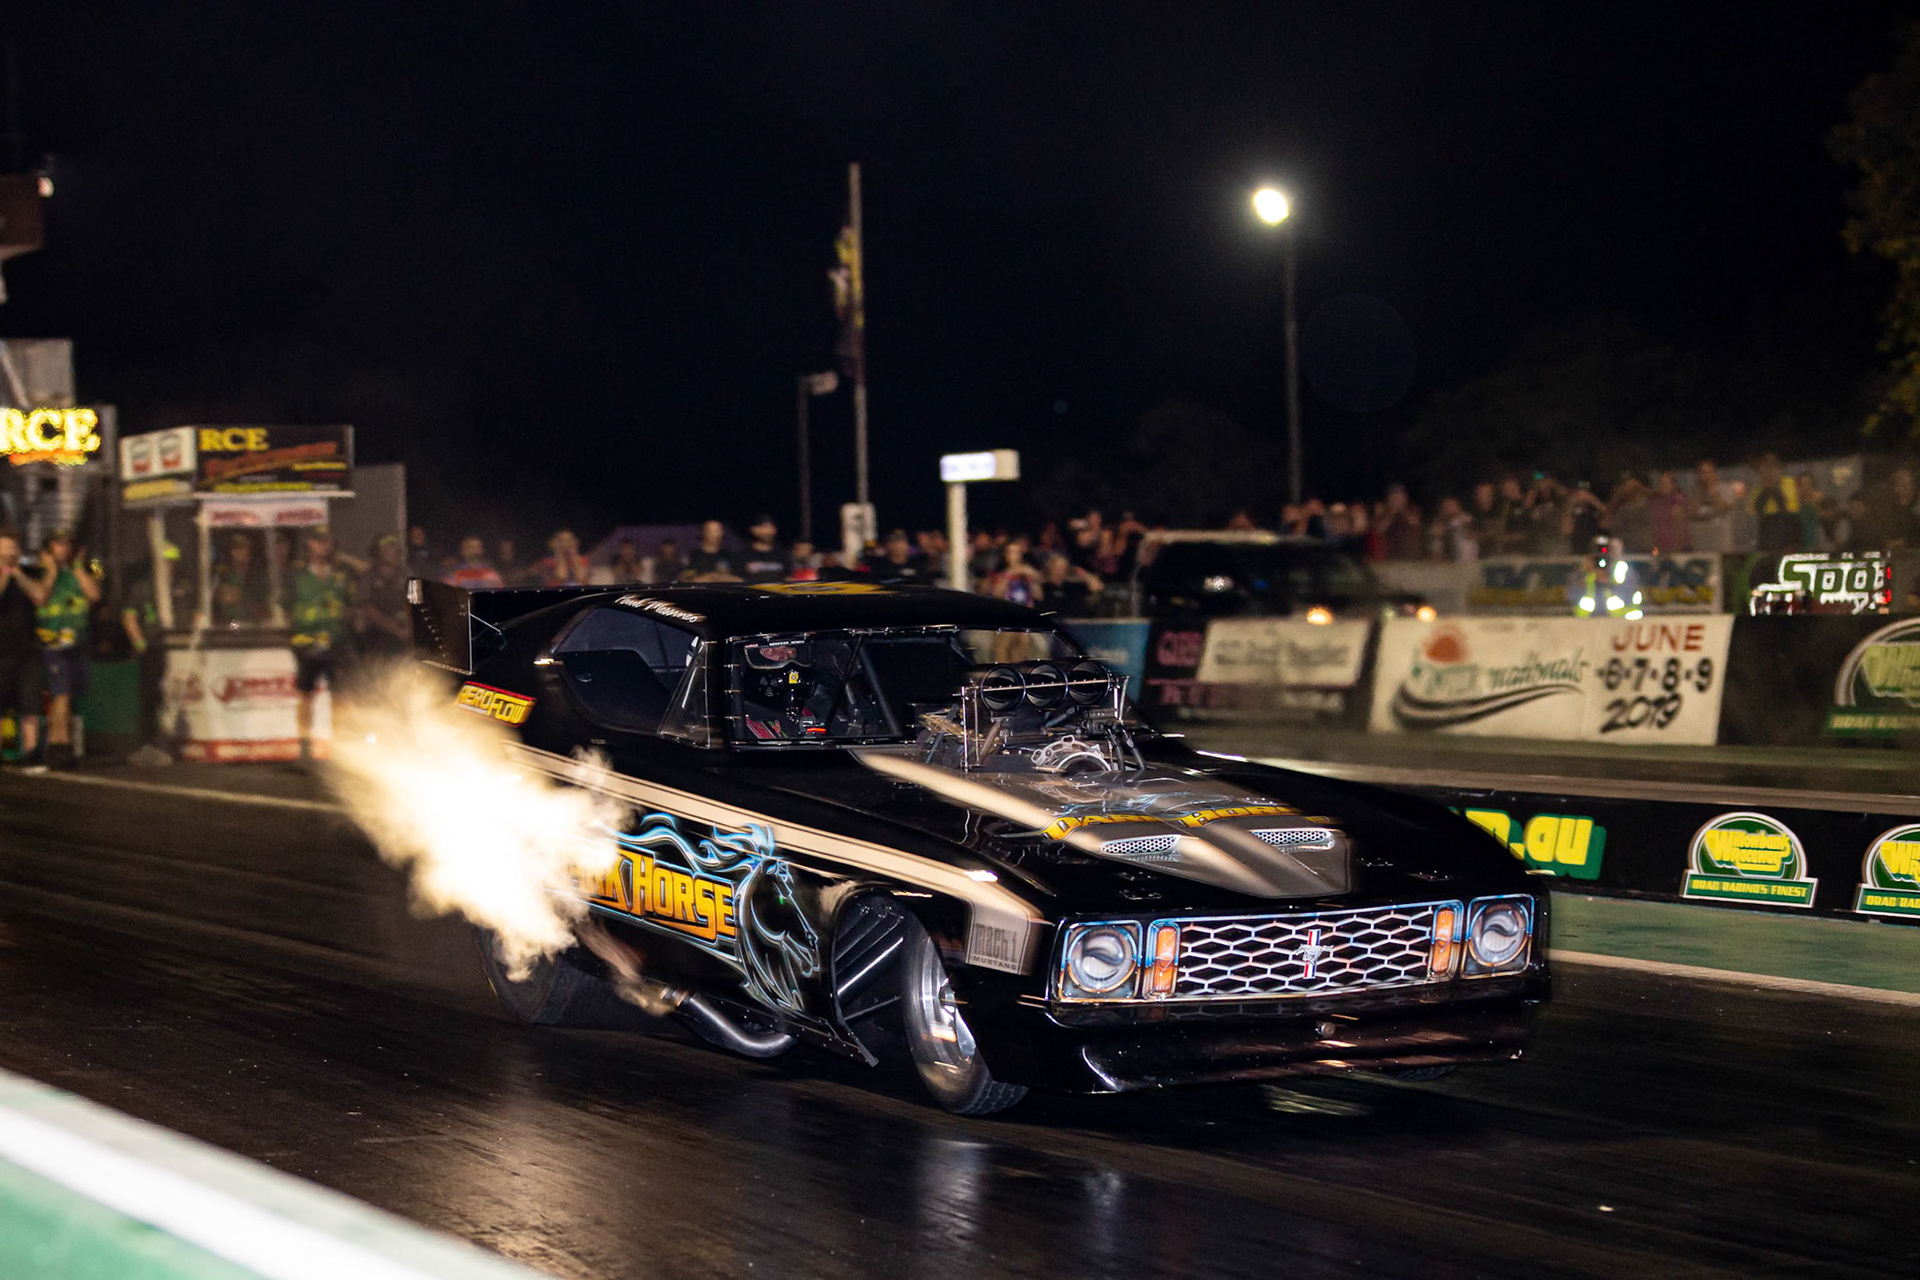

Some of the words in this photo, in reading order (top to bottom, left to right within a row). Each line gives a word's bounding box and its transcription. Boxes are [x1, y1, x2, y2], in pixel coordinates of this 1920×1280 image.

[1611, 624, 1706, 652] JUNE
[1600, 692, 1683, 734] 2019
[620, 849, 736, 940] HORSE
[1771, 885, 1808, 898] FINEST
[973, 955, 1018, 971] MUSTANG
